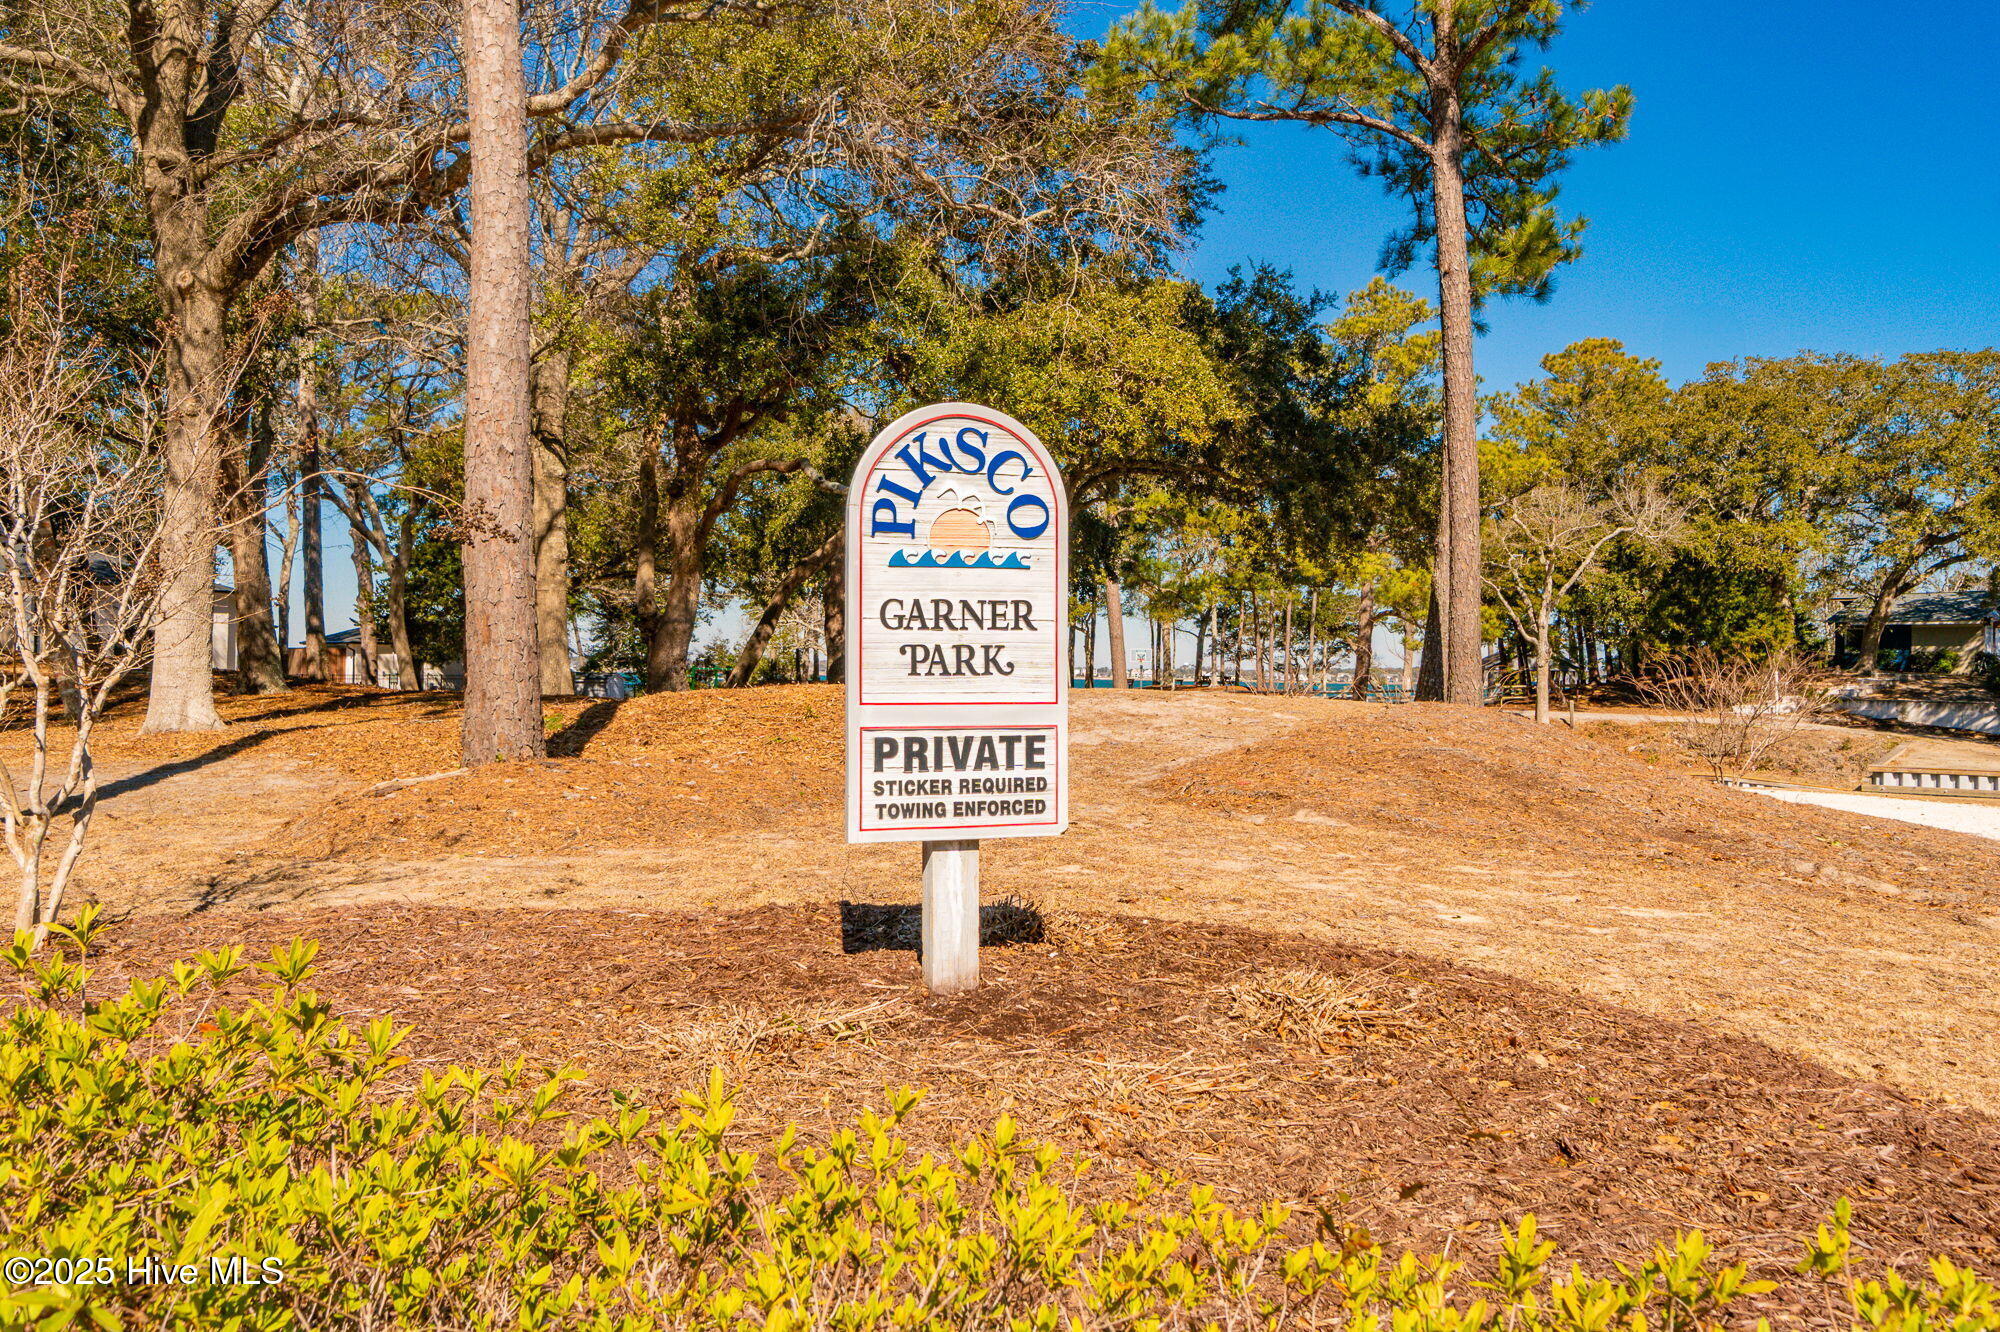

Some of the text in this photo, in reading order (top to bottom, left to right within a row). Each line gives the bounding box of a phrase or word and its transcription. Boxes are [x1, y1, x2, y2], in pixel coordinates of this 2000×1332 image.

[871, 427, 1050, 541] PIKSCO
[879, 598, 1038, 632] GARNER
[900, 644, 1015, 677] PARK
[873, 735, 1047, 774] PRIVATE
[873, 776, 1048, 797] STICKER REQUIRED
[875, 799, 1047, 820] TOWING ENFORCED
